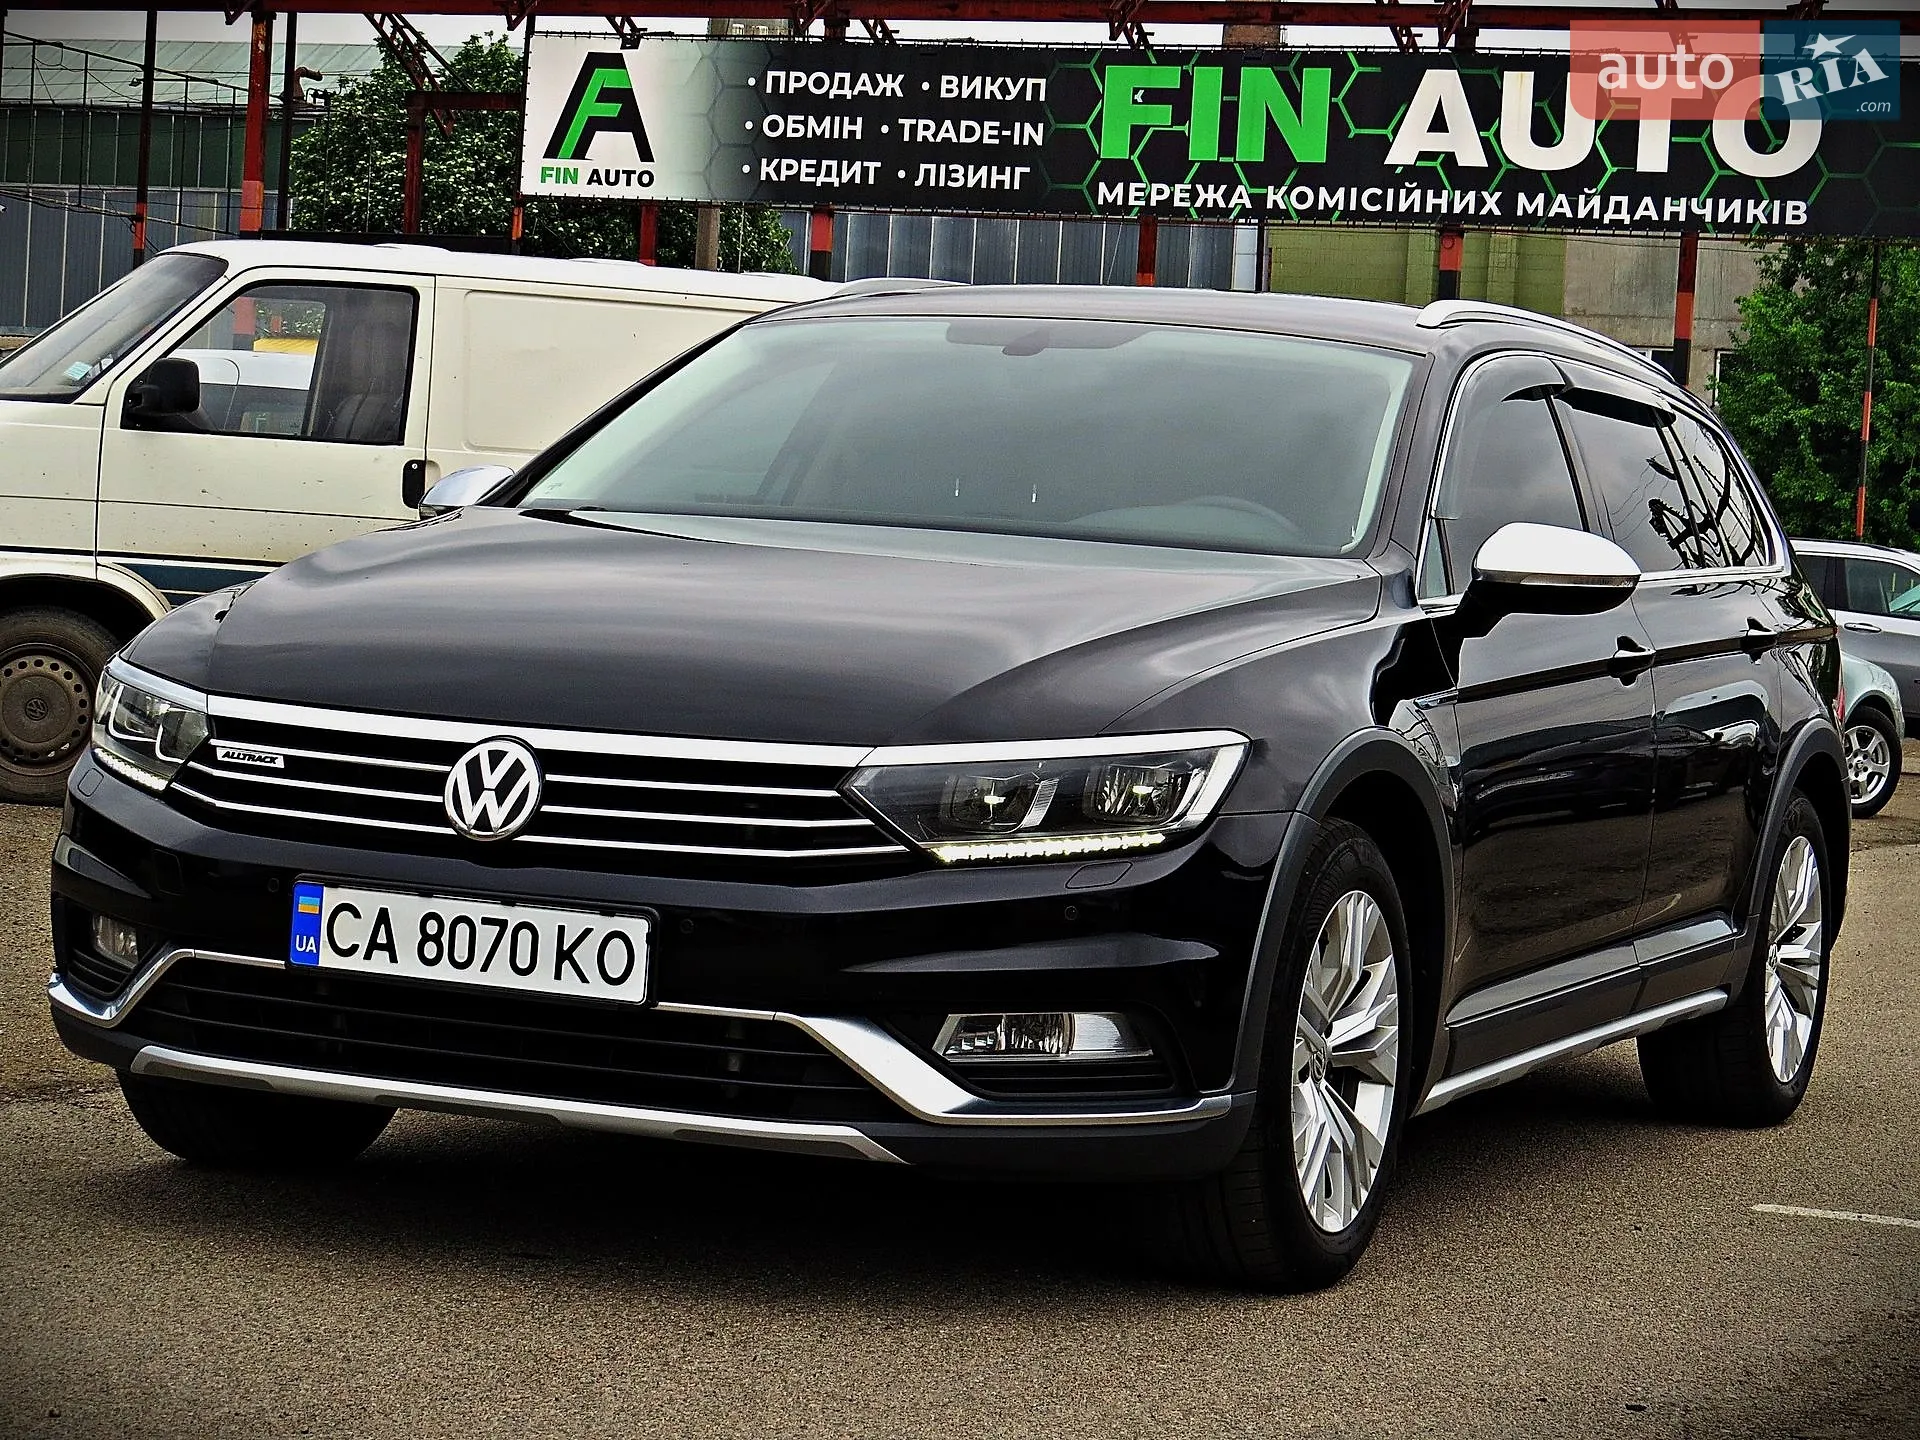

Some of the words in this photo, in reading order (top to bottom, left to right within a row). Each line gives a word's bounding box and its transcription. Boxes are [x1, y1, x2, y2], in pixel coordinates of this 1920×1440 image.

[765, 69, 905, 99] ПРОДАЖ
[939, 74, 1048, 102] ВИКУП
[762, 114, 863, 141] ОБМІН
[897, 118, 1045, 147] TRADE-IN
[1100, 65, 1332, 163] FIN
[1383, 69, 1823, 178] AUTO
[540, 166, 579, 185] FIN
[586, 167, 655, 188] AUTO
[758, 157, 882, 188] КРЕДИТ
[914, 161, 1031, 191] ЛІЗИНГ
[1096, 181, 1252, 210] МЕРЕЖА
[1267, 182, 1502, 217] КОМІСІЙНИХ
[1516, 187, 1808, 226] МАЙДАНЧИКІВ
[221, 750, 279, 765] ALLTRACK
[444, 738, 541, 841] VW
[295, 935, 317, 955] UA
[326, 902, 399, 964] CA
[416, 911, 541, 977] 8070
[554, 925, 635, 986] KO
